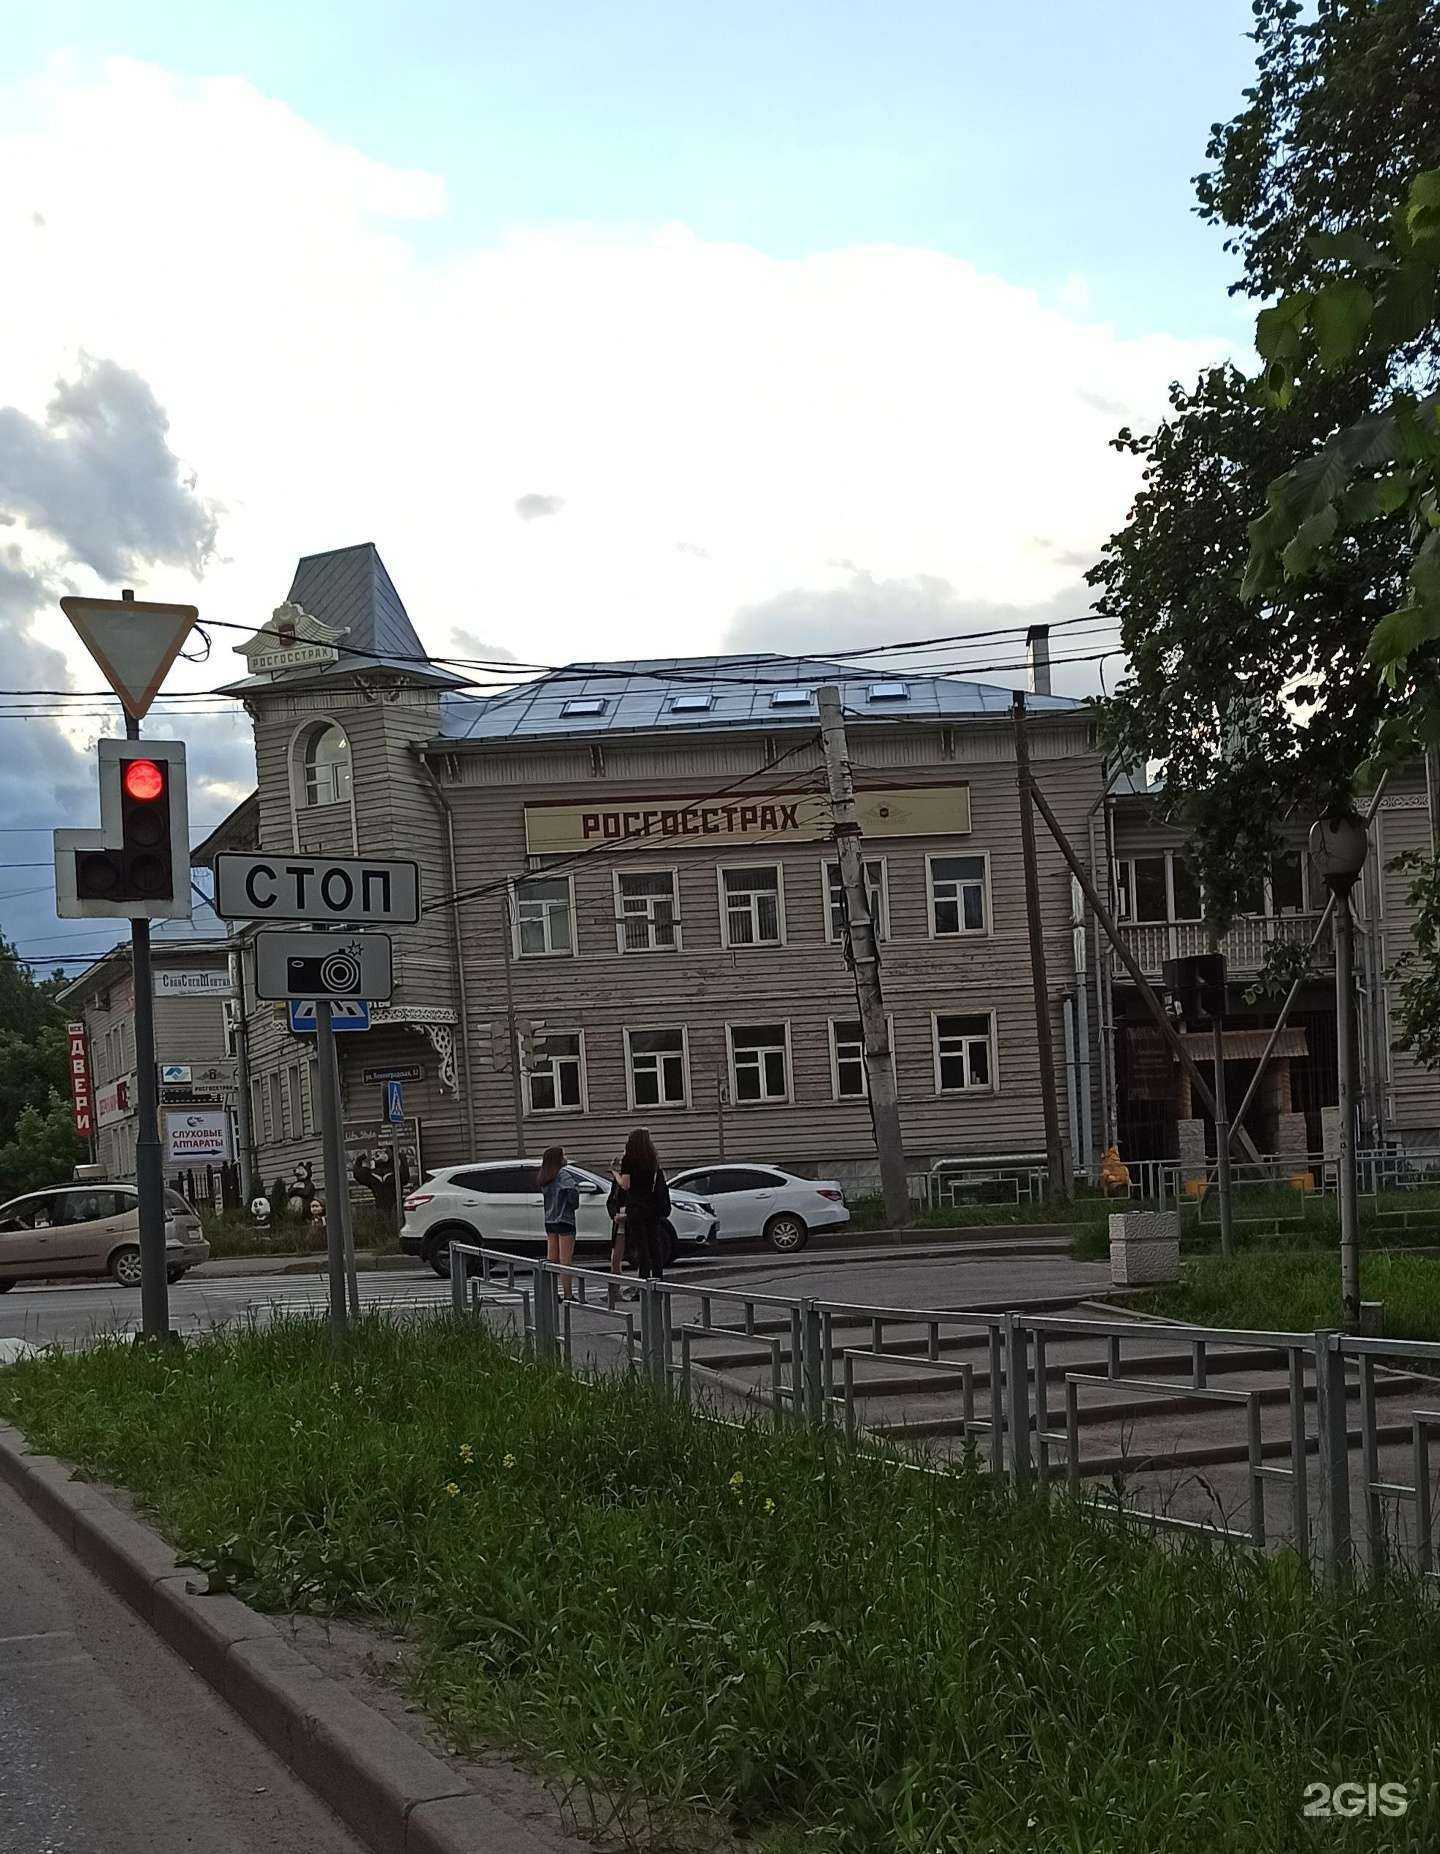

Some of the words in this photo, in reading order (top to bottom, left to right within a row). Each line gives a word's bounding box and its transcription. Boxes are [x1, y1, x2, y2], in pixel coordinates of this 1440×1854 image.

[251, 647, 328, 669] РОСГОССТРАХ
[582, 804, 799, 840] РОСГОССТРАХ
[245, 864, 391, 913] СТОП
[71, 1039, 90, 1129] ДВЕРИ
[172, 1129, 223, 1139] СЛУХОВЫЕ
[173, 1139, 223, 1148] АППАРАТЫ
